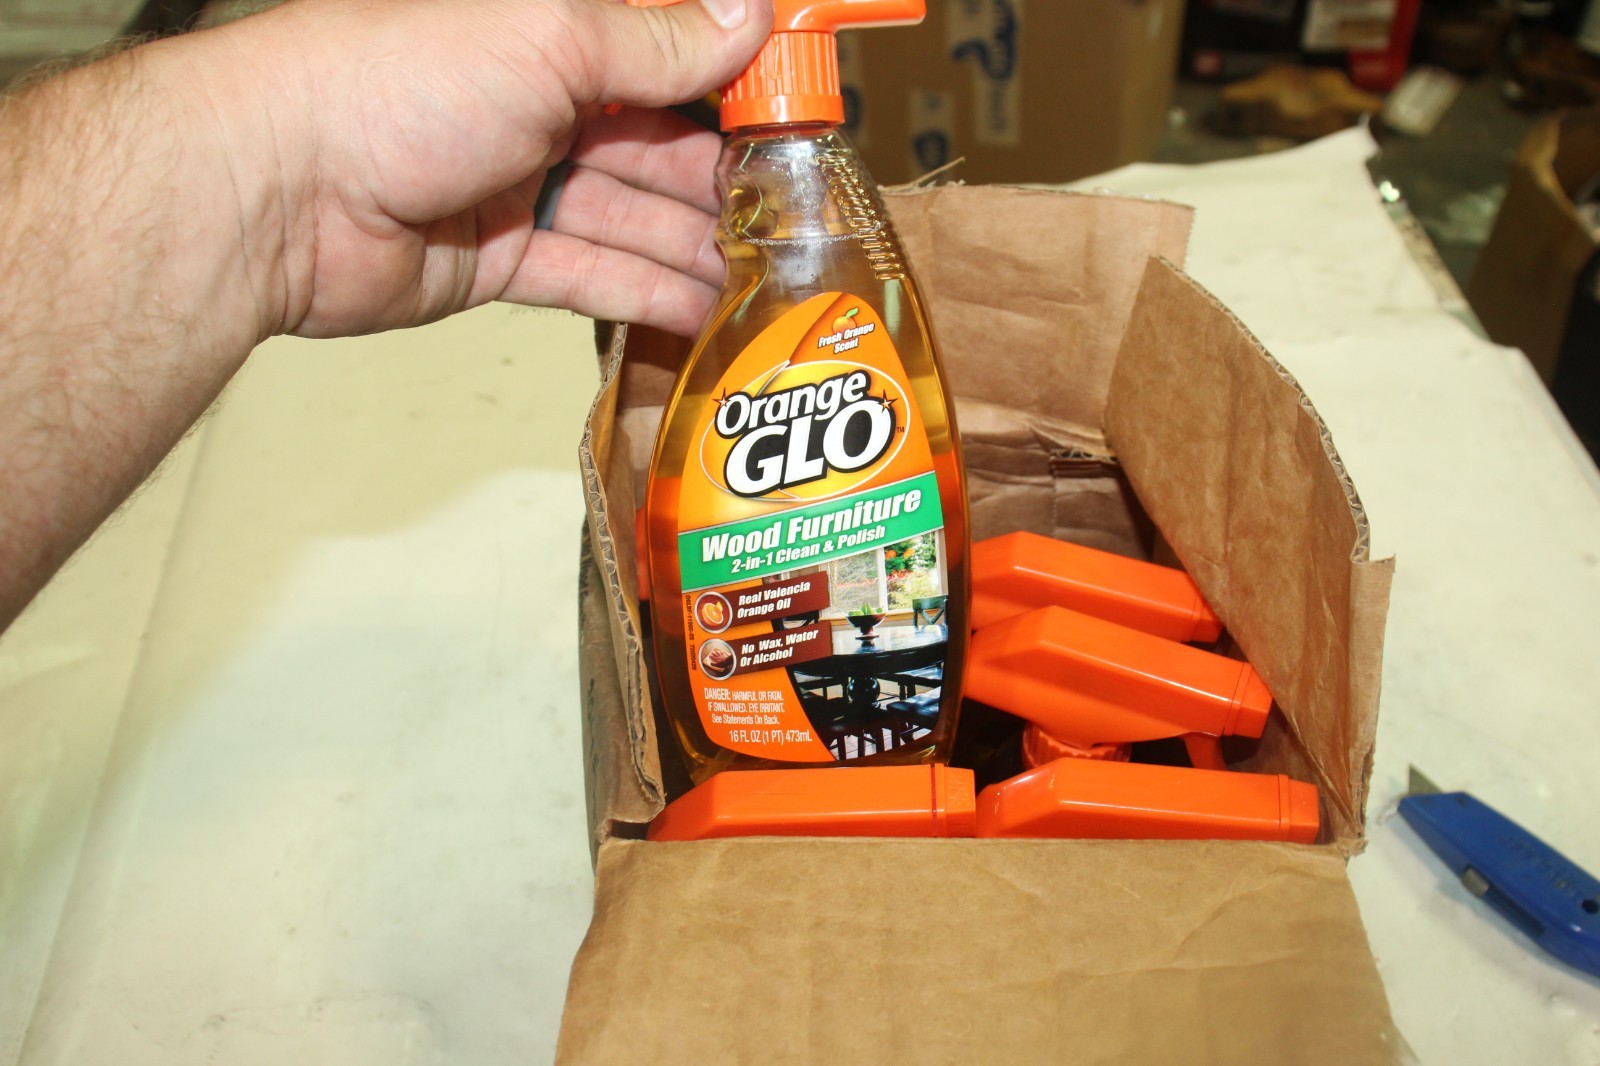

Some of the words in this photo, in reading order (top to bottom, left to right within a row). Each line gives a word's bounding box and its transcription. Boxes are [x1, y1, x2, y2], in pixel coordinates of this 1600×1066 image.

[818, 332, 842, 348] Fresh
[843, 322, 875, 340] Orange
[834, 337, 859, 354] Scent
[715, 370, 869, 438] Orange
[724, 398, 894, 496] GLO
[702, 522, 782, 563] Wood
[787, 488, 922, 545] Furniture
[730, 554, 773, 574] 2-in-1
[775, 540, 820, 565] Clean
[822, 539, 835, 553] &
[837, 524, 886, 550] Polish
[738, 591, 763, 606] Real
[763, 581, 811, 601] Valencia
[737, 602, 775, 619] Orange
[776, 597, 792, 611] Oil
[741, 643, 755, 655] No
[758, 637, 784, 652] Wax,
[785, 629, 819, 646] Water
[740, 656, 752, 668] Or
[752, 646, 794, 665] Alcohol
[703, 687, 731, 700] DANGER:
[731, 690, 757, 701] HARMFUL
[758, 690, 766, 701] OR
[767, 690, 784, 701] FATAL
[707, 701, 713, 712] IF
[748, 702, 759, 713] EYE
[760, 702, 785, 713] IRRITANT.
[711, 713, 722, 724] See
[722, 713, 754, 725] Statements
[754, 714, 763, 725] On
[763, 714, 780, 725] Back.
[729, 729, 739, 743] 16
[740, 729, 749, 743] FL
[750, 729, 761, 743] OZ
[762, 729, 769, 746] (1
[771, 729, 784, 746] PT)
[785, 729, 813, 743] 473mL
